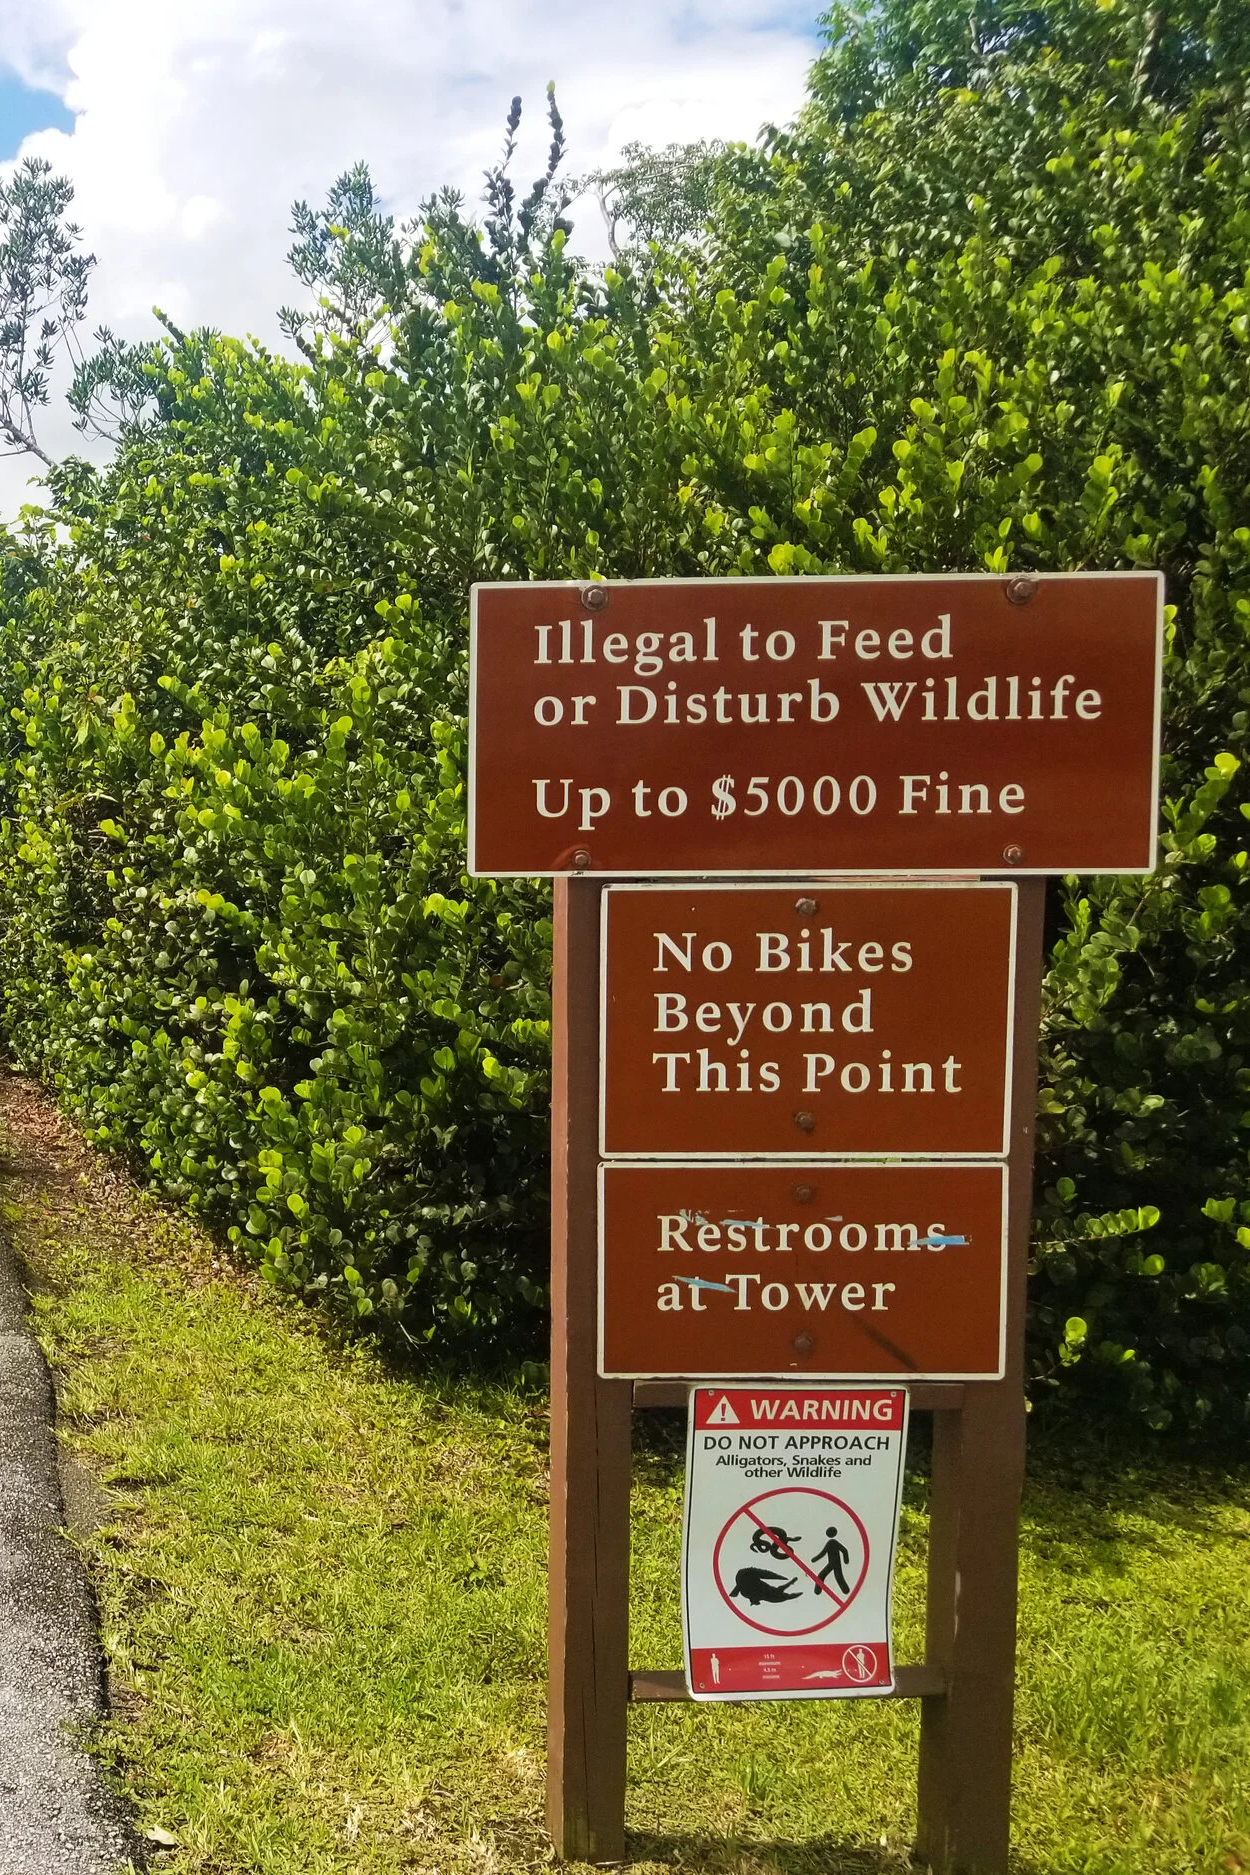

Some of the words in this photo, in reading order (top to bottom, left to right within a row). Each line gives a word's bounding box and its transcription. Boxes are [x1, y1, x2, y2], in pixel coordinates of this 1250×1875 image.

[534, 617, 718, 676] Illegal
[740, 624, 796, 661] to
[818, 614, 954, 660] Feed
[534, 696, 596, 726] or
[616, 679, 839, 724] Disturb
[861, 675, 1102, 722] Wildlife
[532, 778, 610, 830] Up
[632, 780, 688, 817] to
[711, 774, 877, 821] $5000
[899, 772, 1025, 814] Fine
[652, 932, 732, 972] No
[755, 928, 913, 972] Bikes
[653, 988, 874, 1045] Beyond
[652, 1048, 781, 1092] This
[802, 1050, 962, 1093] Point
[657, 1214, 947, 1252] Restrooms
[657, 1276, 707, 1311] at
[726, 1274, 896, 1311] Tower
[751, 1399, 892, 1421] WARNING
[704, 1436, 732, 1450] DO
[738, 1436, 779, 1450] NOT
[785, 1436, 890, 1450] APPROACH
[716, 1455, 787, 1468] Alligators,
[793, 1455, 841, 1466] Snakes
[845, 1455, 872, 1466] and
[744, 1467, 783, 1478] other
[787, 1467, 842, 1478] Wildlife
